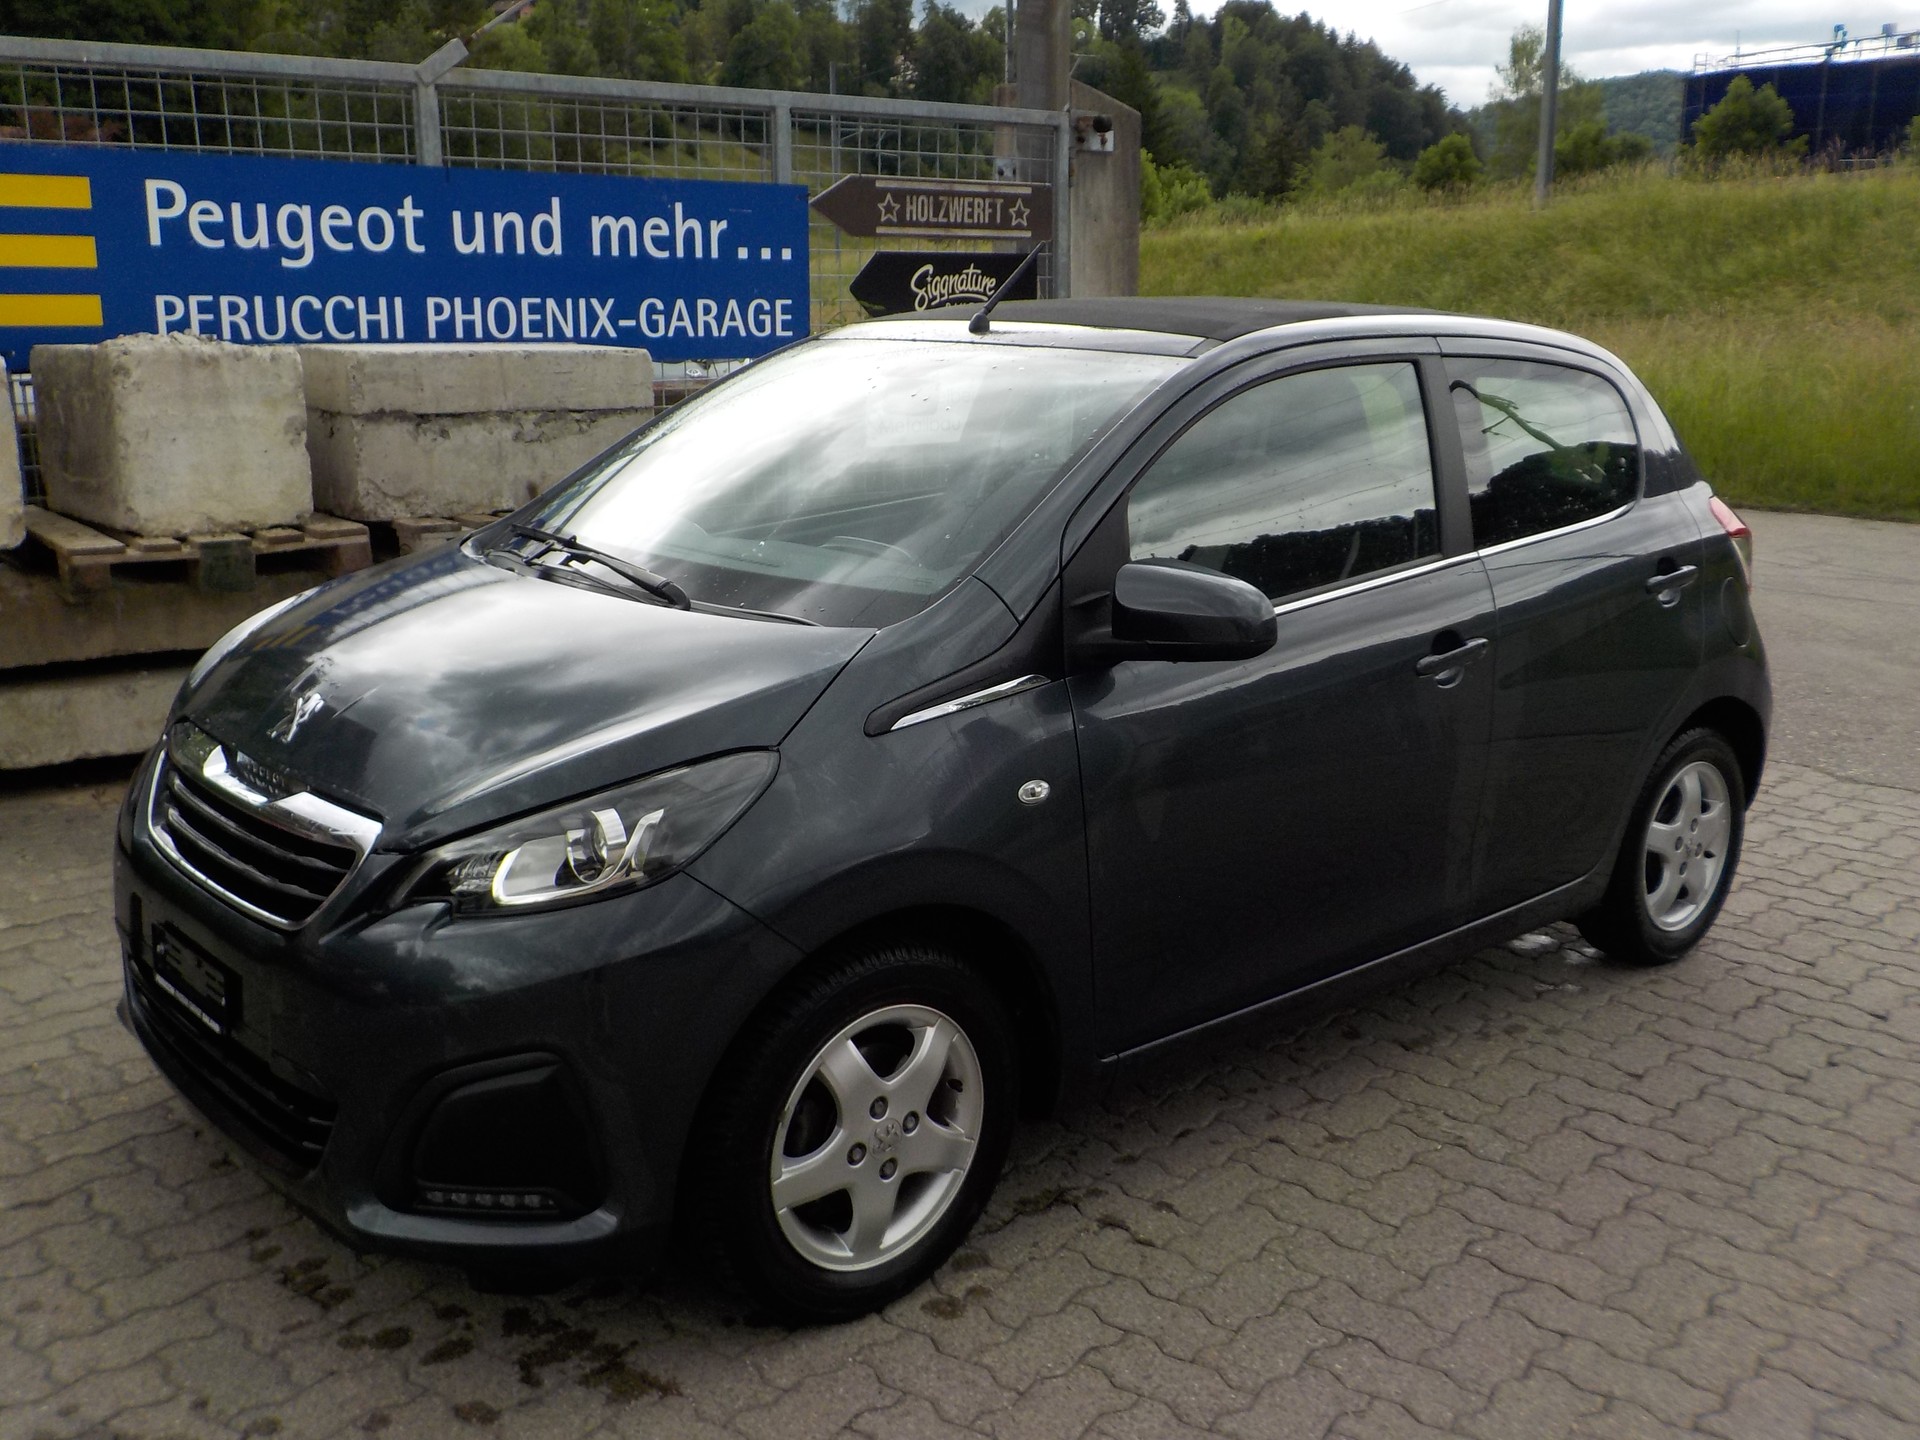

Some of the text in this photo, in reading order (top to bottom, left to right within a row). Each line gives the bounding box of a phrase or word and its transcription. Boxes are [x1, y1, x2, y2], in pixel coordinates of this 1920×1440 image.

[144, 178, 793, 268] Peugeot und mehr...
[905, 194, 1004, 224] HOLZWERFT
[910, 262, 997, 312] Siggnature
[155, 294, 793, 341] PERUCCHI PHOENIX-GARAGE
